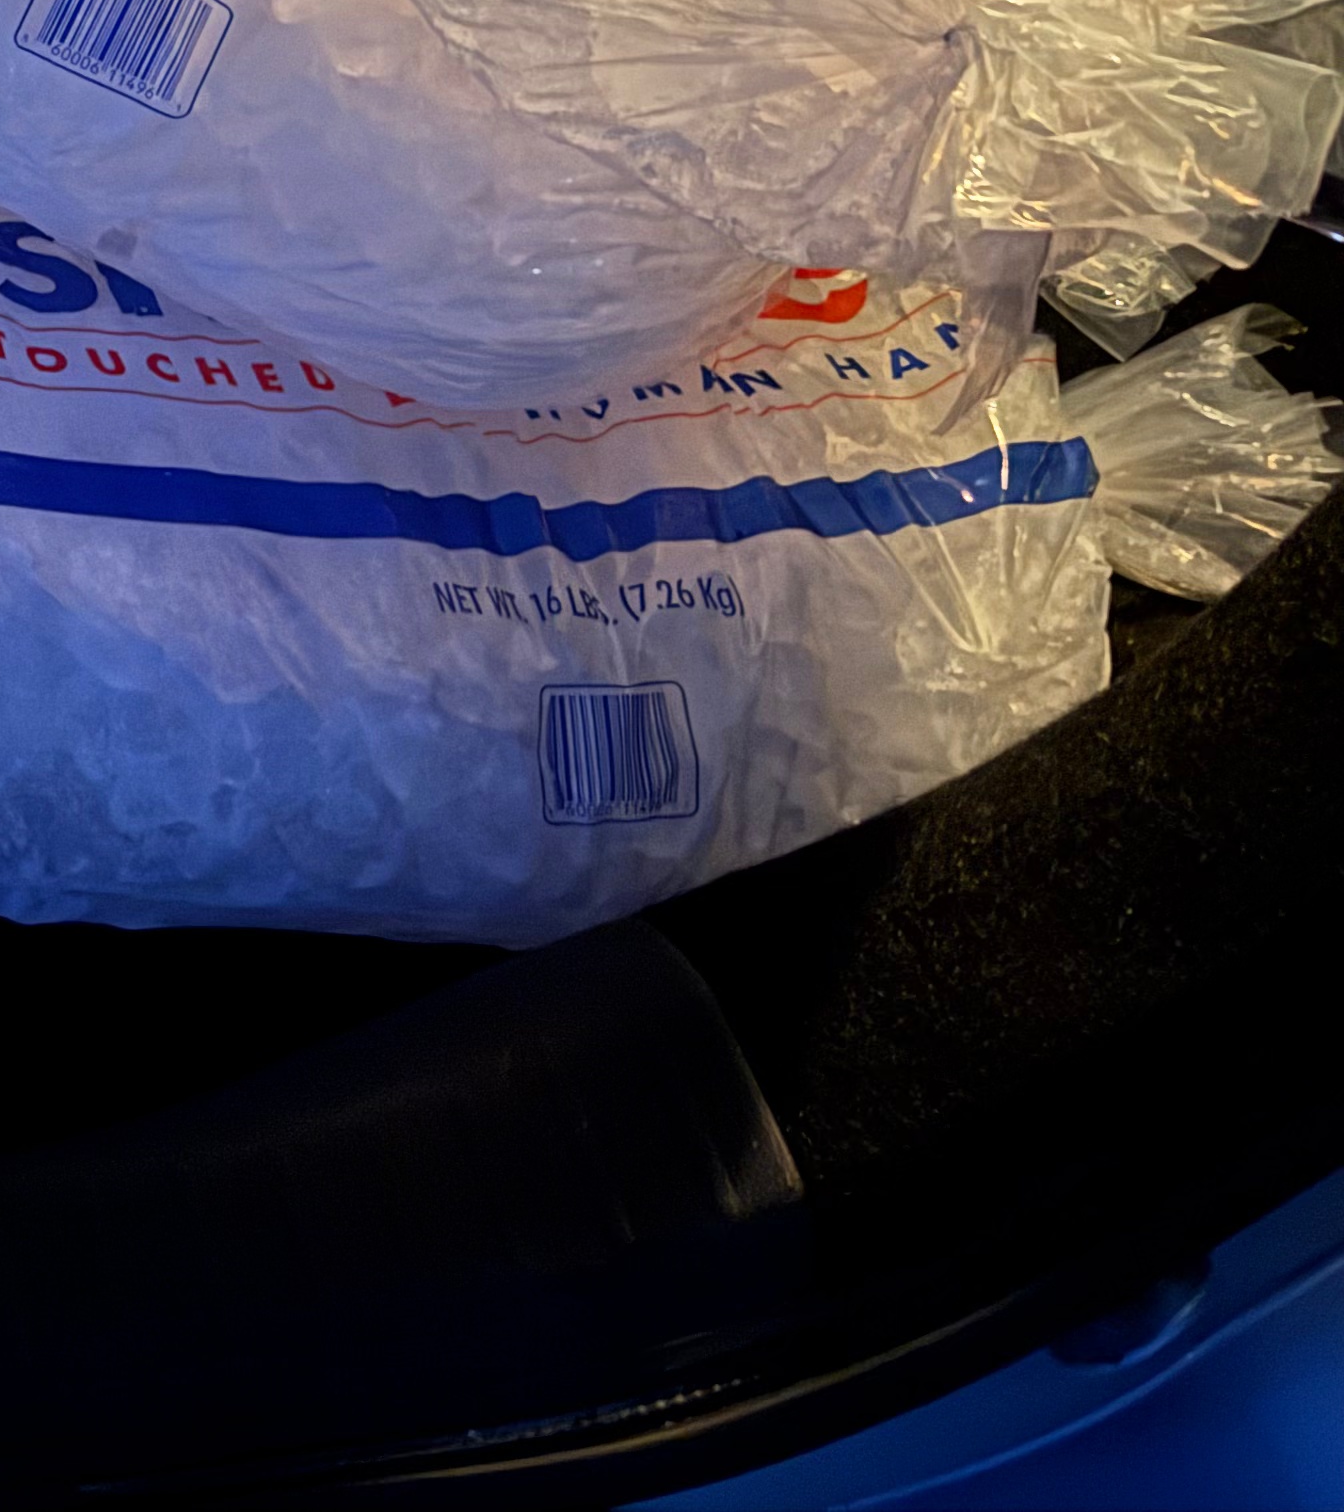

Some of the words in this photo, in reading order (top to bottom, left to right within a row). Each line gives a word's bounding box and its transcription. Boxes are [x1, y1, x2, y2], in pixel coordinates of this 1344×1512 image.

[50, 43, 100, 75] 60006
[108, 69, 154, 100] 11496
[432, 581, 483, 615] NET
[486, 585, 529, 624] WT.
[530, 585, 562, 622] 16
[619, 578, 695, 623] (7.26
[697, 576, 746, 617] Kg)
